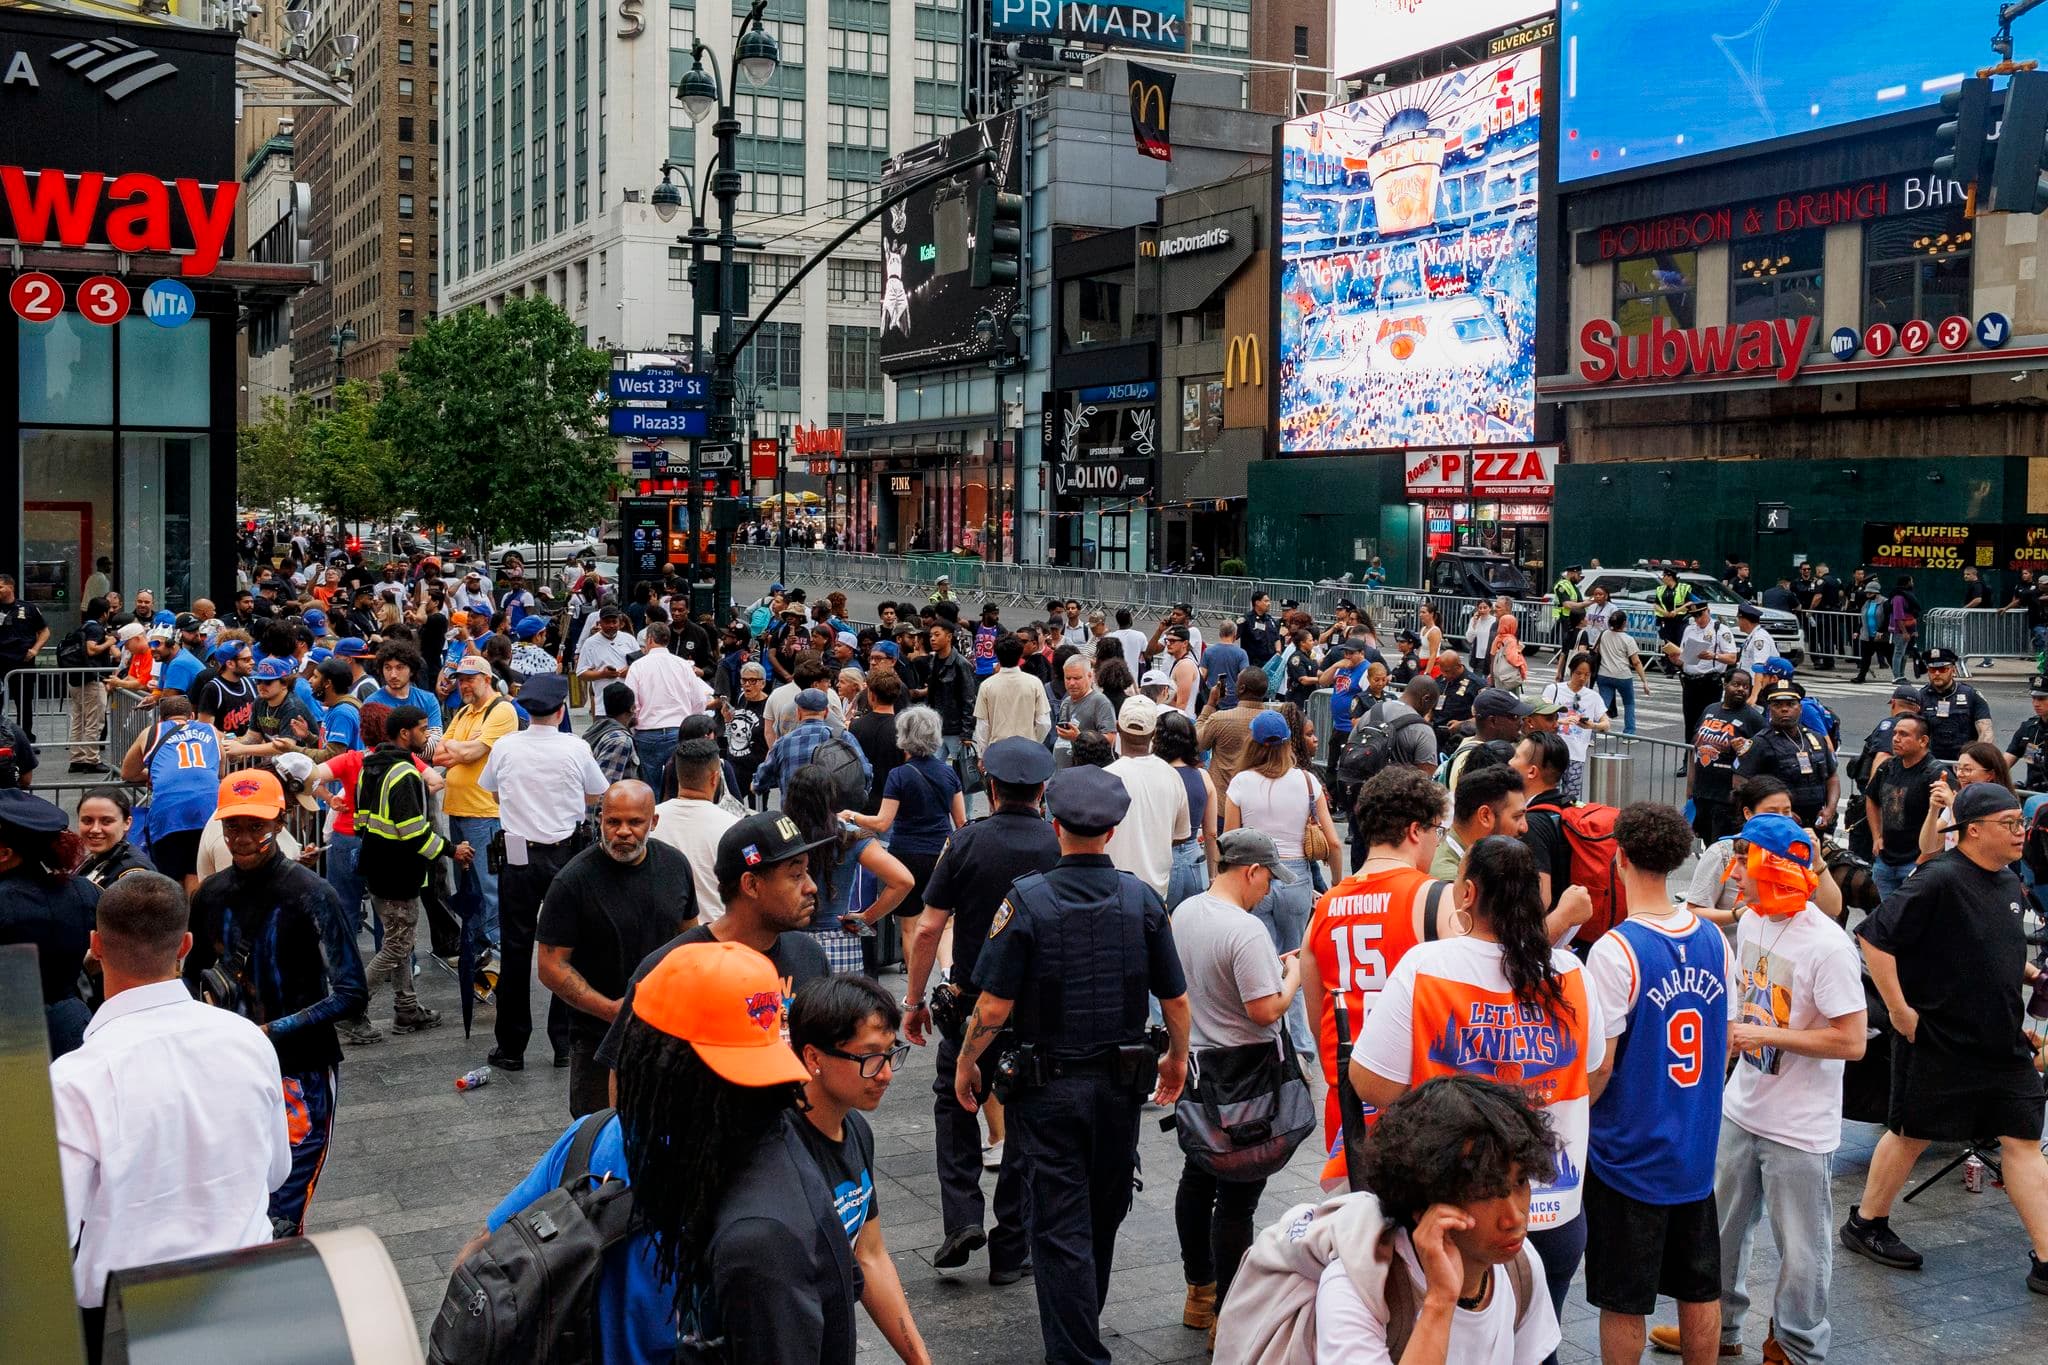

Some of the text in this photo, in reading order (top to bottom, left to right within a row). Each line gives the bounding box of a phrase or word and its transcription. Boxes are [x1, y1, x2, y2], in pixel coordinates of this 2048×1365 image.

[1003, 0, 1177, 43] PRIMARK
[3, 51, 40, 87] A
[1600, 183, 1889, 260] BOURBON & BRANCH
[1158, 227, 1230, 257] McDonald's
[1419, 233, 1513, 268] Nowhere
[24, 281, 188, 318] 2 3 MTA
[1579, 315, 1960, 383] Subway MTA 1 2 3
[619, 378, 701, 394] West 33rd St
[633, 414, 686, 430] Plaza33
[795, 423, 843, 457] Subway
[704, 450, 728, 462] ONE WAY
[1407, 450, 1545, 484] ROSE'S PZZA
[666, 464, 690, 475] mac
[1076, 464, 1119, 489] OLIYO
[891, 476, 911, 491] PINK
[1429, 508, 1450, 519] PIZZA
[1906, 526, 1969, 538] FLUFFIES
[2036, 527, 2048, 539] FL
[1878, 545, 1958, 559] OPENING
[1927, 559, 1965, 569] 2027
[1627, 613, 1658, 631] NYP
[1695, 727, 1730, 747] Finals
[1702, 720, 1736, 737] NBA
[176, 742, 207, 769] 11
[1327, 892, 1392, 918] ANTHONY
[1330, 924, 1388, 992] 15
[1647, 966, 1725, 1011] BARRETT
[1518, 1001, 1545, 1024] GO
[1457, 1025, 1558, 1066] KNICKS
[1667, 1008, 1704, 1088] 9
[1529, 1213, 1556, 1224] INALS
[1530, 1201, 1560, 1213] NICKS
